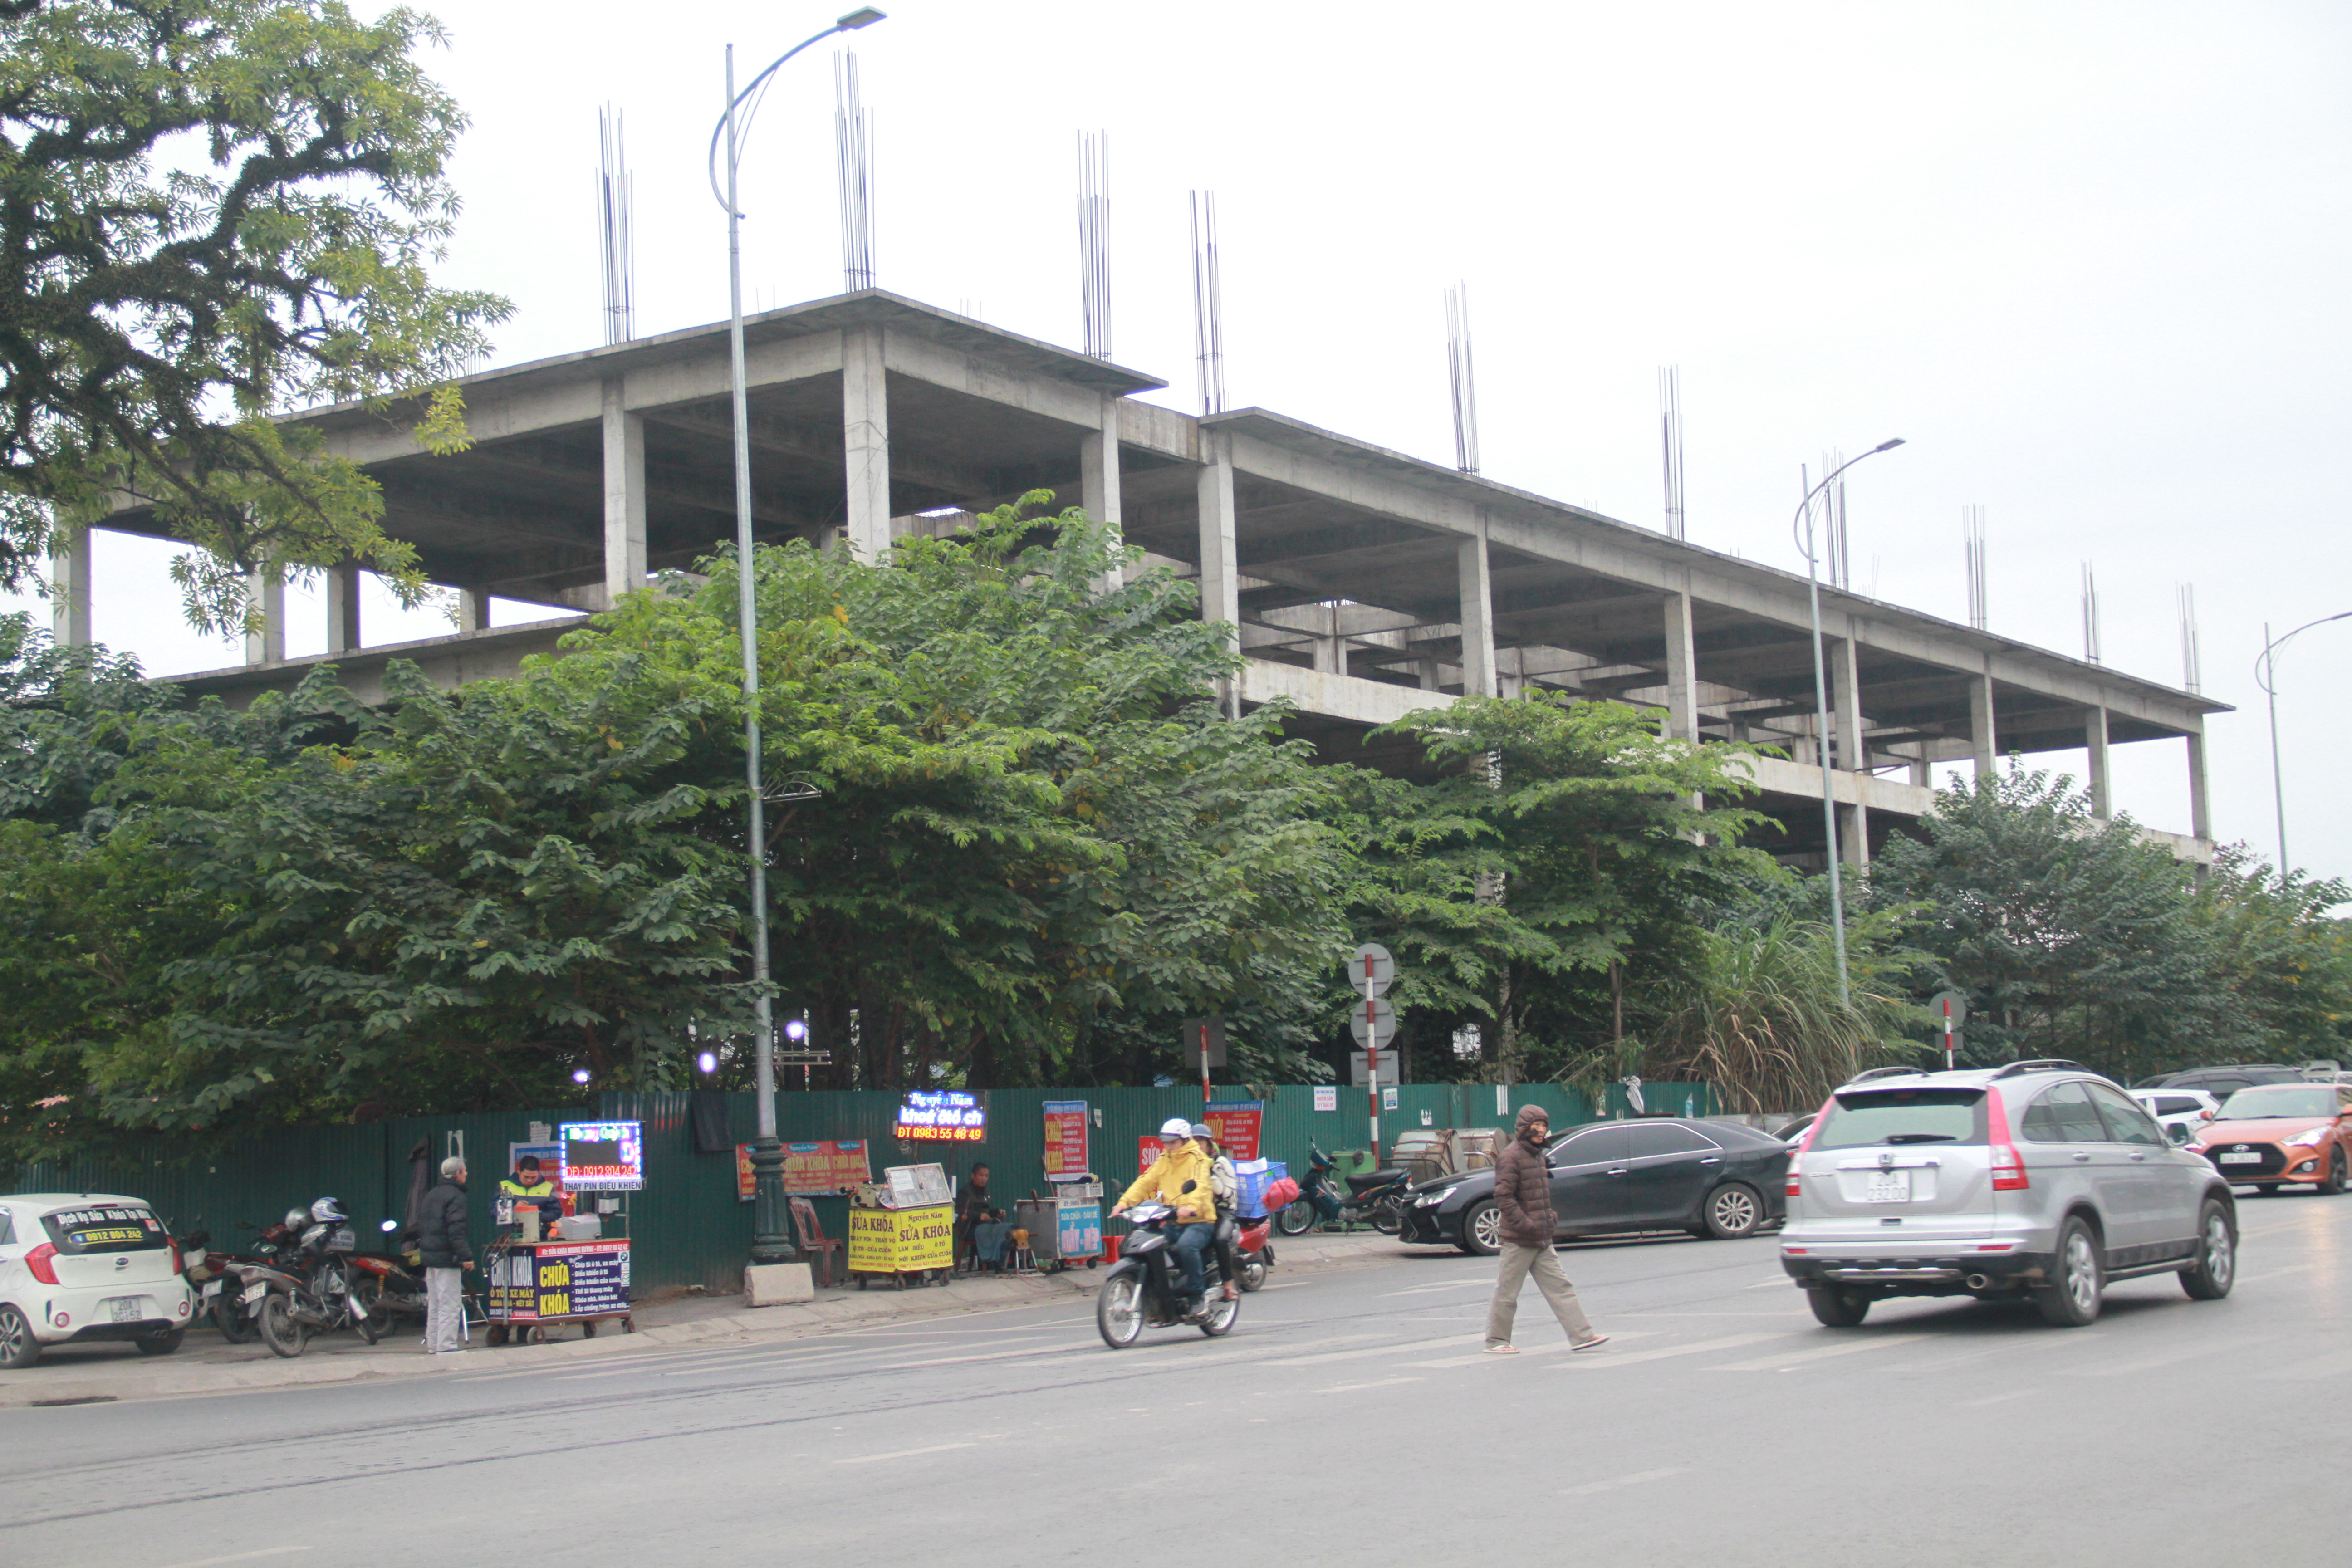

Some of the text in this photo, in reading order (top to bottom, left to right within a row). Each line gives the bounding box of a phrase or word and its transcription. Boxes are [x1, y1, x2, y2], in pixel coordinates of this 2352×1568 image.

[898, 1127, 982, 1140] ĐT 0983 55 48 49
[583, 1166, 603, 1176] 0912
[605, 1166, 620, 1176] 804
[621, 1165, 636, 1176] 242
[57, 1212, 78, 1225] Dịch
[76, 1212, 89, 1224] Vụ
[88, 1210, 105, 1221] Sửa
[852, 1212, 894, 1232] SỬA KHÓA
[85, 1231, 109, 1241] 0912
[126, 1230, 143, 1238] 242
[900, 1221, 951, 1242] SỬA KHÓA
[512, 1250, 533, 1286] KHÓA
[539, 1260, 570, 1288] CHỮA
[509, 1289, 518, 1298] XE
[519, 1287, 534, 1298] MÁY
[539, 1289, 570, 1316] KHÓA
